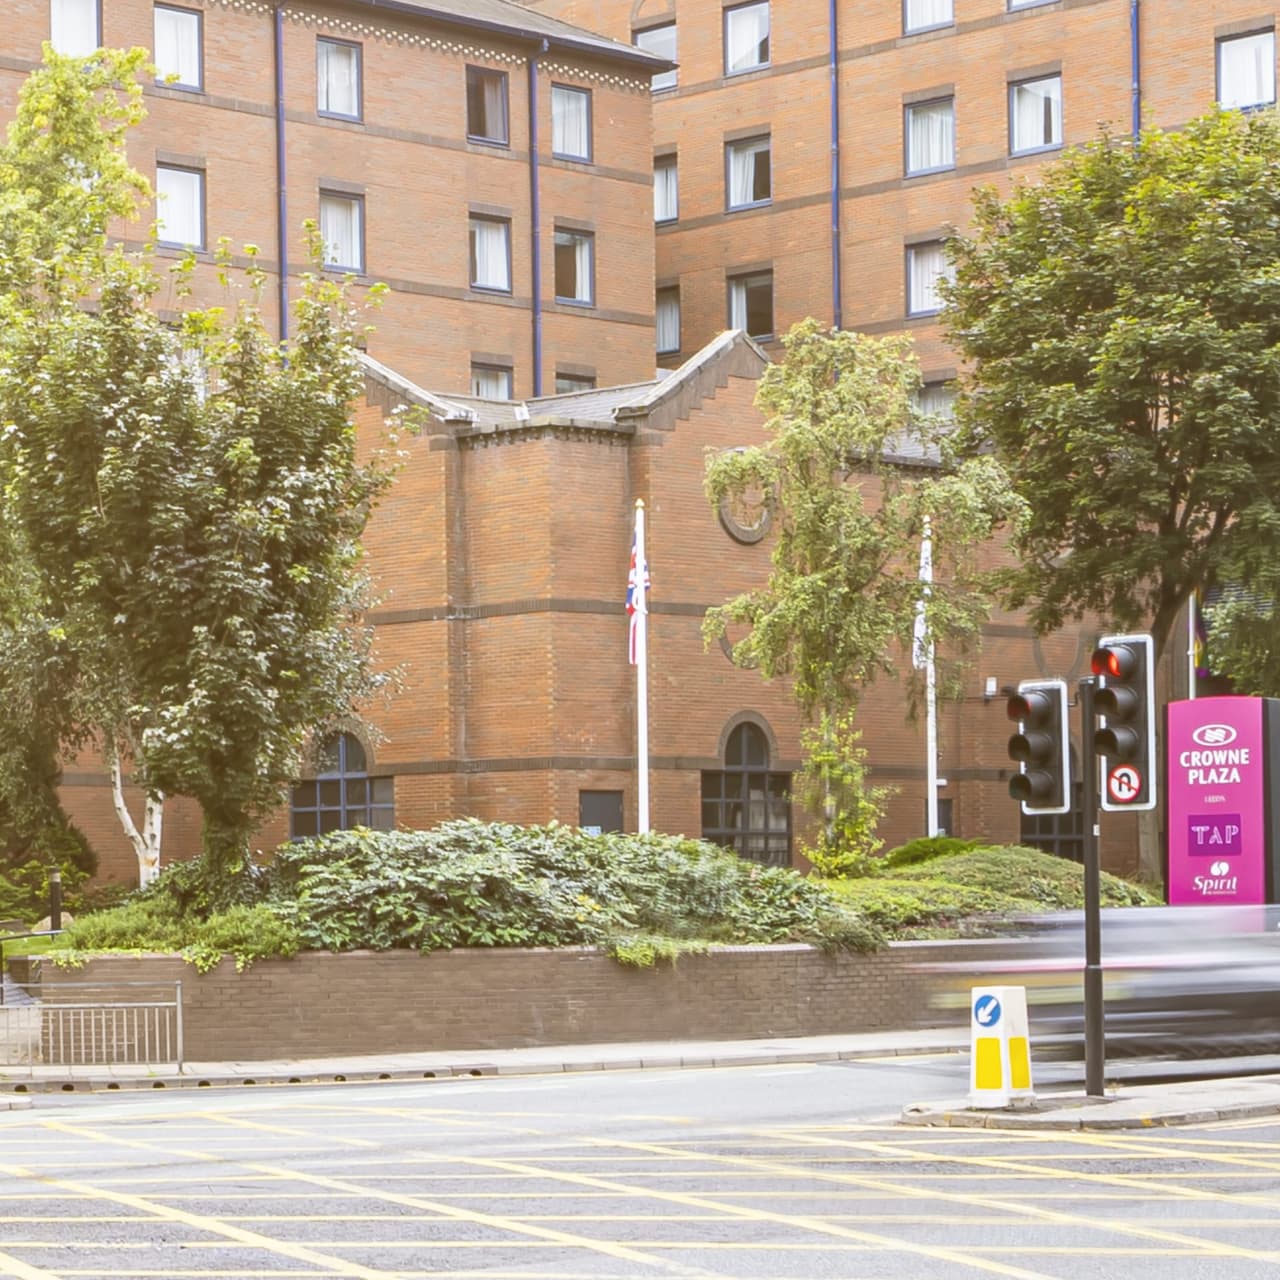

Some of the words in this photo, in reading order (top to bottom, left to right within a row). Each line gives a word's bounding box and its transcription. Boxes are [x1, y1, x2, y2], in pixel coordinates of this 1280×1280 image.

[1179, 748, 1250, 768] CROWNE
[1188, 767, 1241, 785] PLAZA
[1191, 825, 1239, 845] TAP
